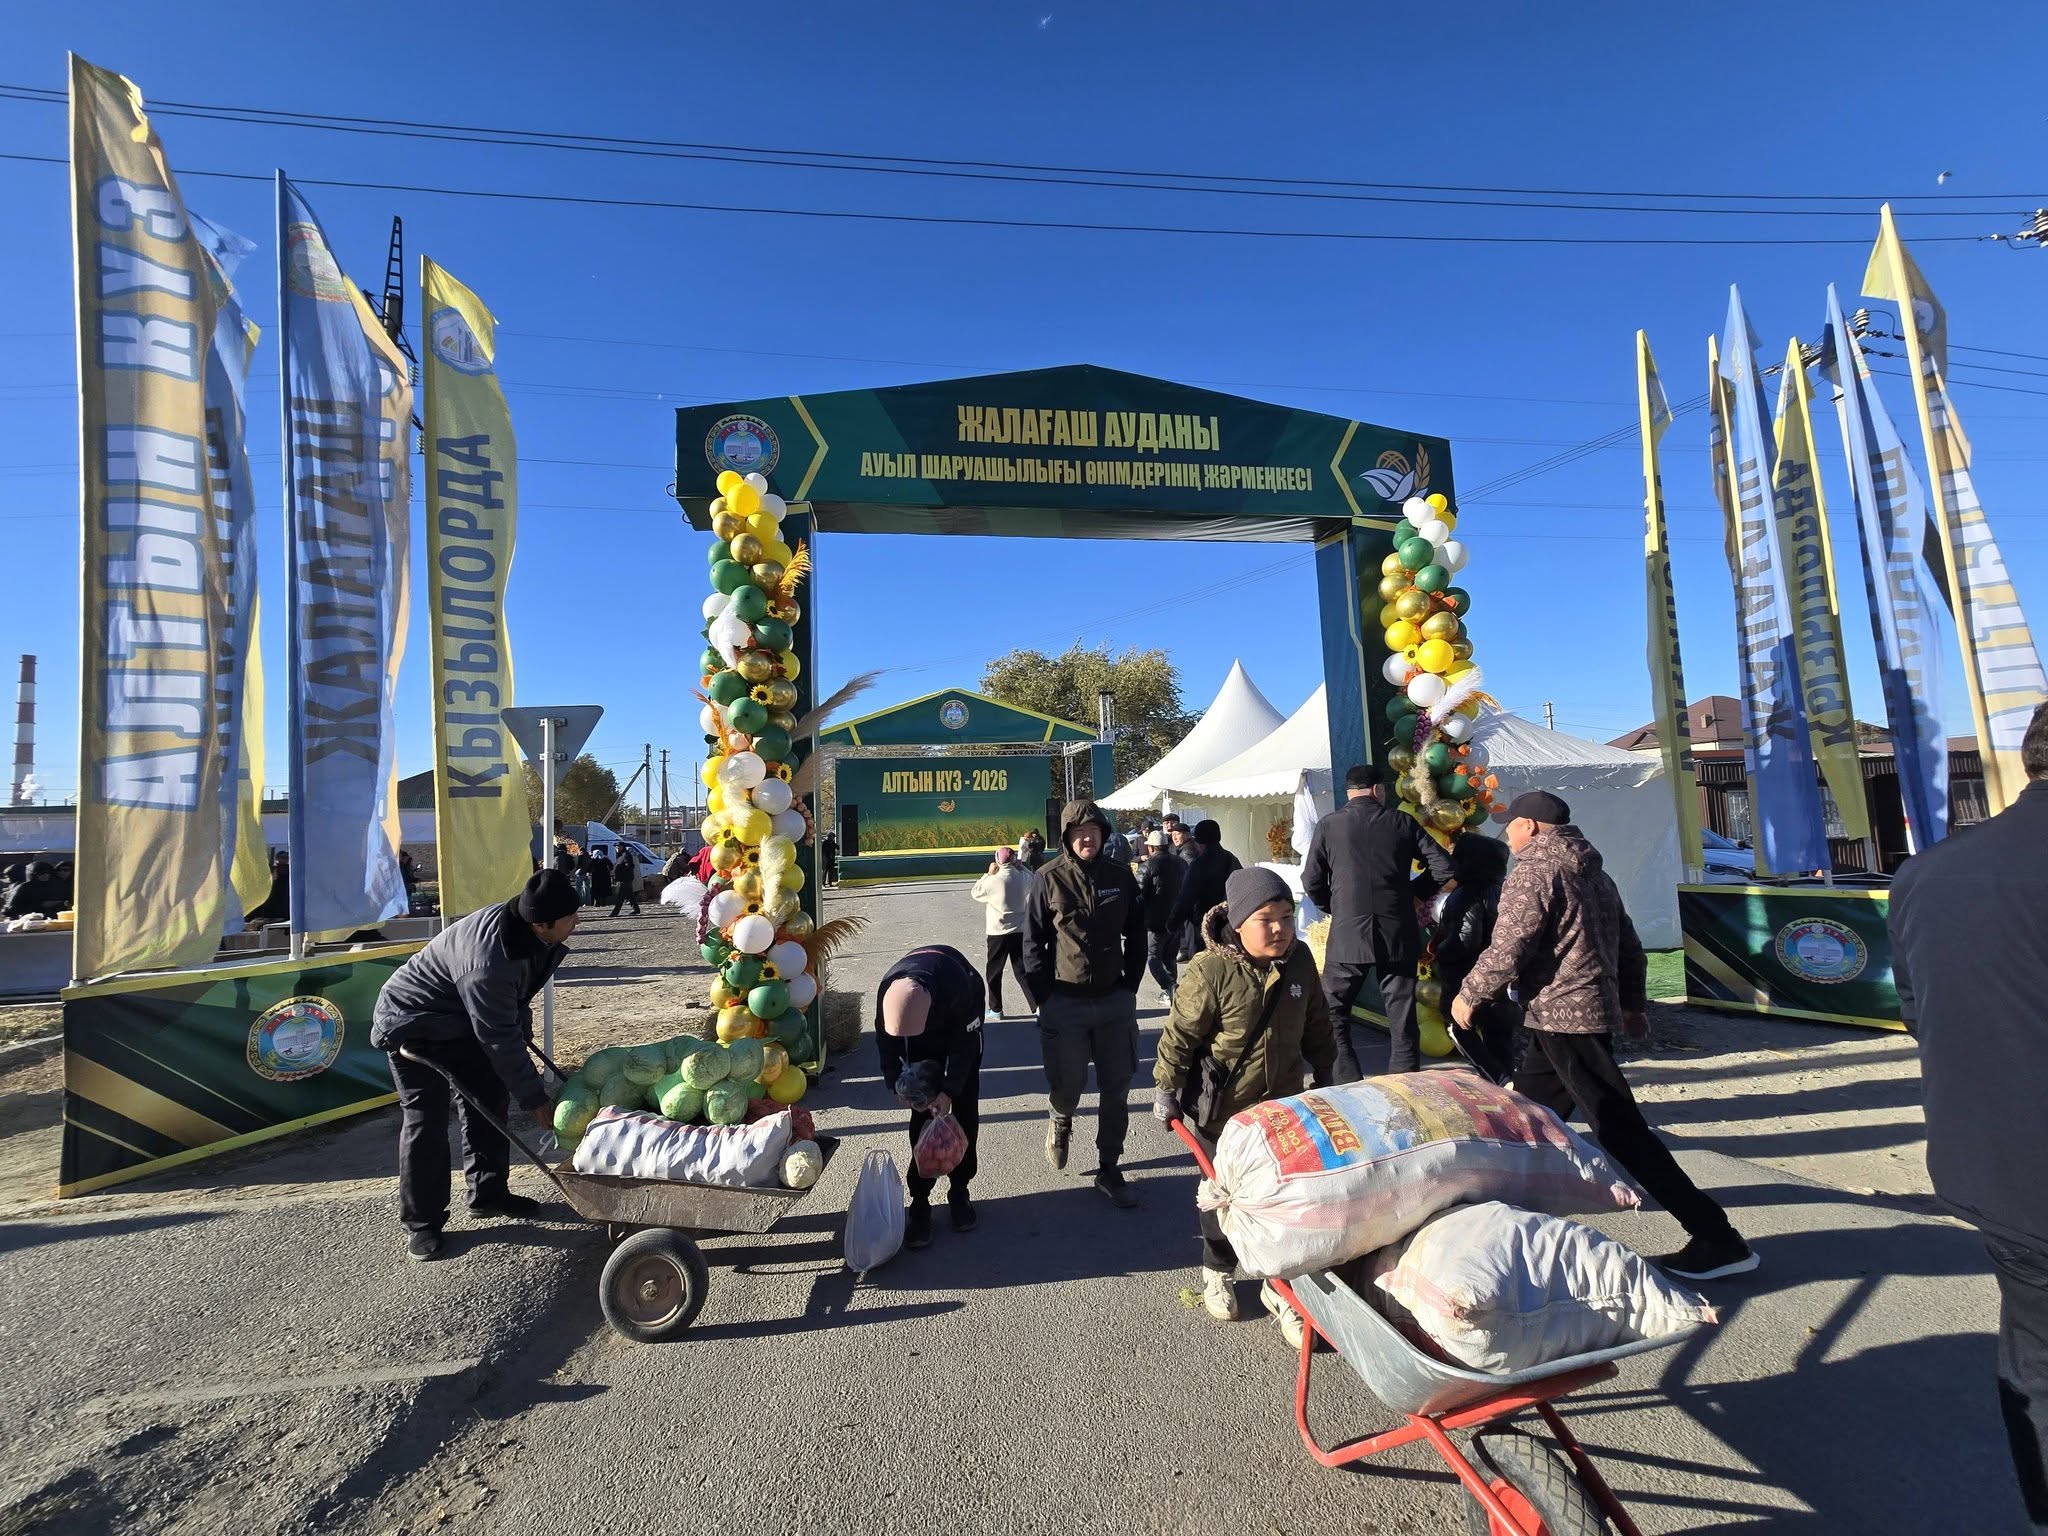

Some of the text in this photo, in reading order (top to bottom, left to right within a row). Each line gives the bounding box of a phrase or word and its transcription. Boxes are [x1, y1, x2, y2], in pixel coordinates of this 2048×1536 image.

[860, 452, 1312, 493] АУЫЛ ШАРУАШЫЛЫҒЫ ӨНІМДЕРІНІҢ ЖӘРМЕҢКЕСІ
[957, 405, 1219, 454] ЖАЛАҒАШ АУДАНЫ
[93, 424, 207, 812] АЛТЫН
[292, 397, 377, 765] ЖАЛАҒАШ
[435, 434, 509, 799] ҚЫЗЫЛОРДА
[882, 771, 933, 793] АЛТЫН
[935, 770, 962, 792] КҮЗ
[972, 770, 1008, 791] 2026
